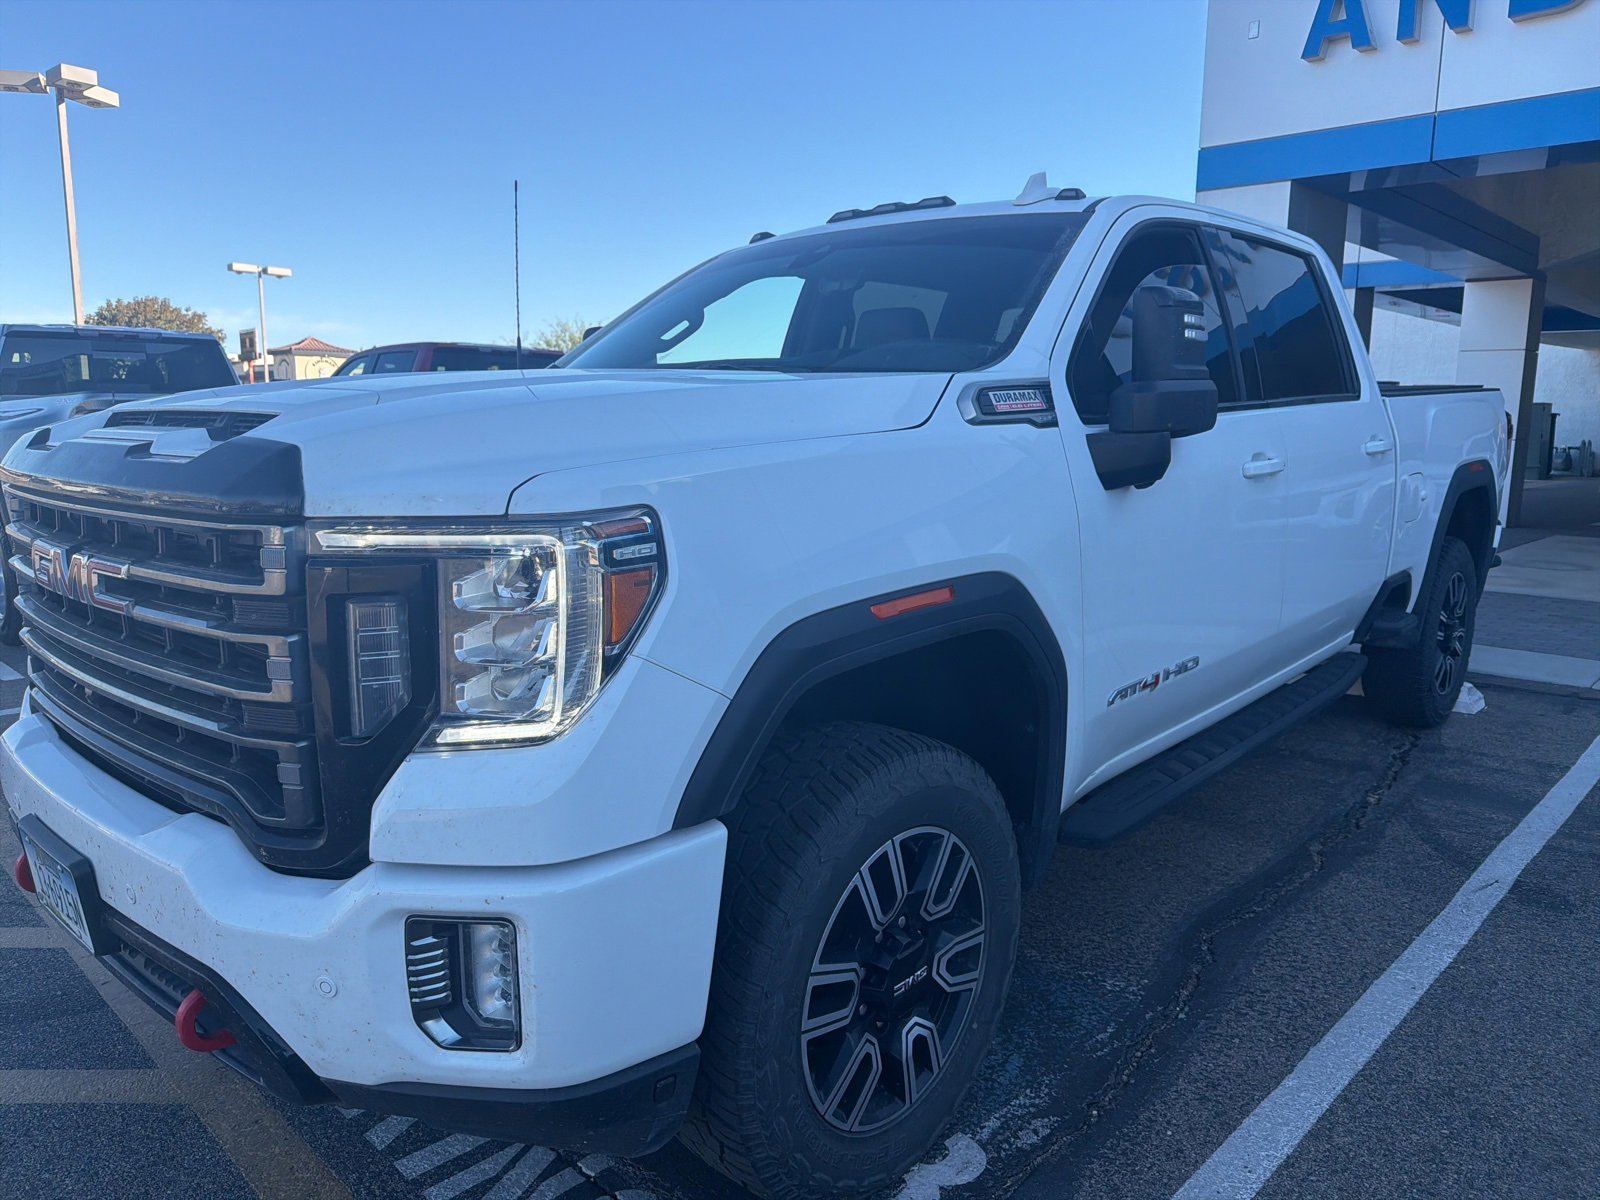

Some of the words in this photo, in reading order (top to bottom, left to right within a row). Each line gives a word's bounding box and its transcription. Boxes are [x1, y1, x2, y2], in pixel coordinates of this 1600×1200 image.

[992, 390, 1040, 404] DURAMAX
[613, 542, 658, 560] HD
[31, 538, 131, 615] GMC
[1107, 671, 1161, 707] AT4
[1161, 656, 1200, 682] HD
[893, 965, 928, 997] GMC
